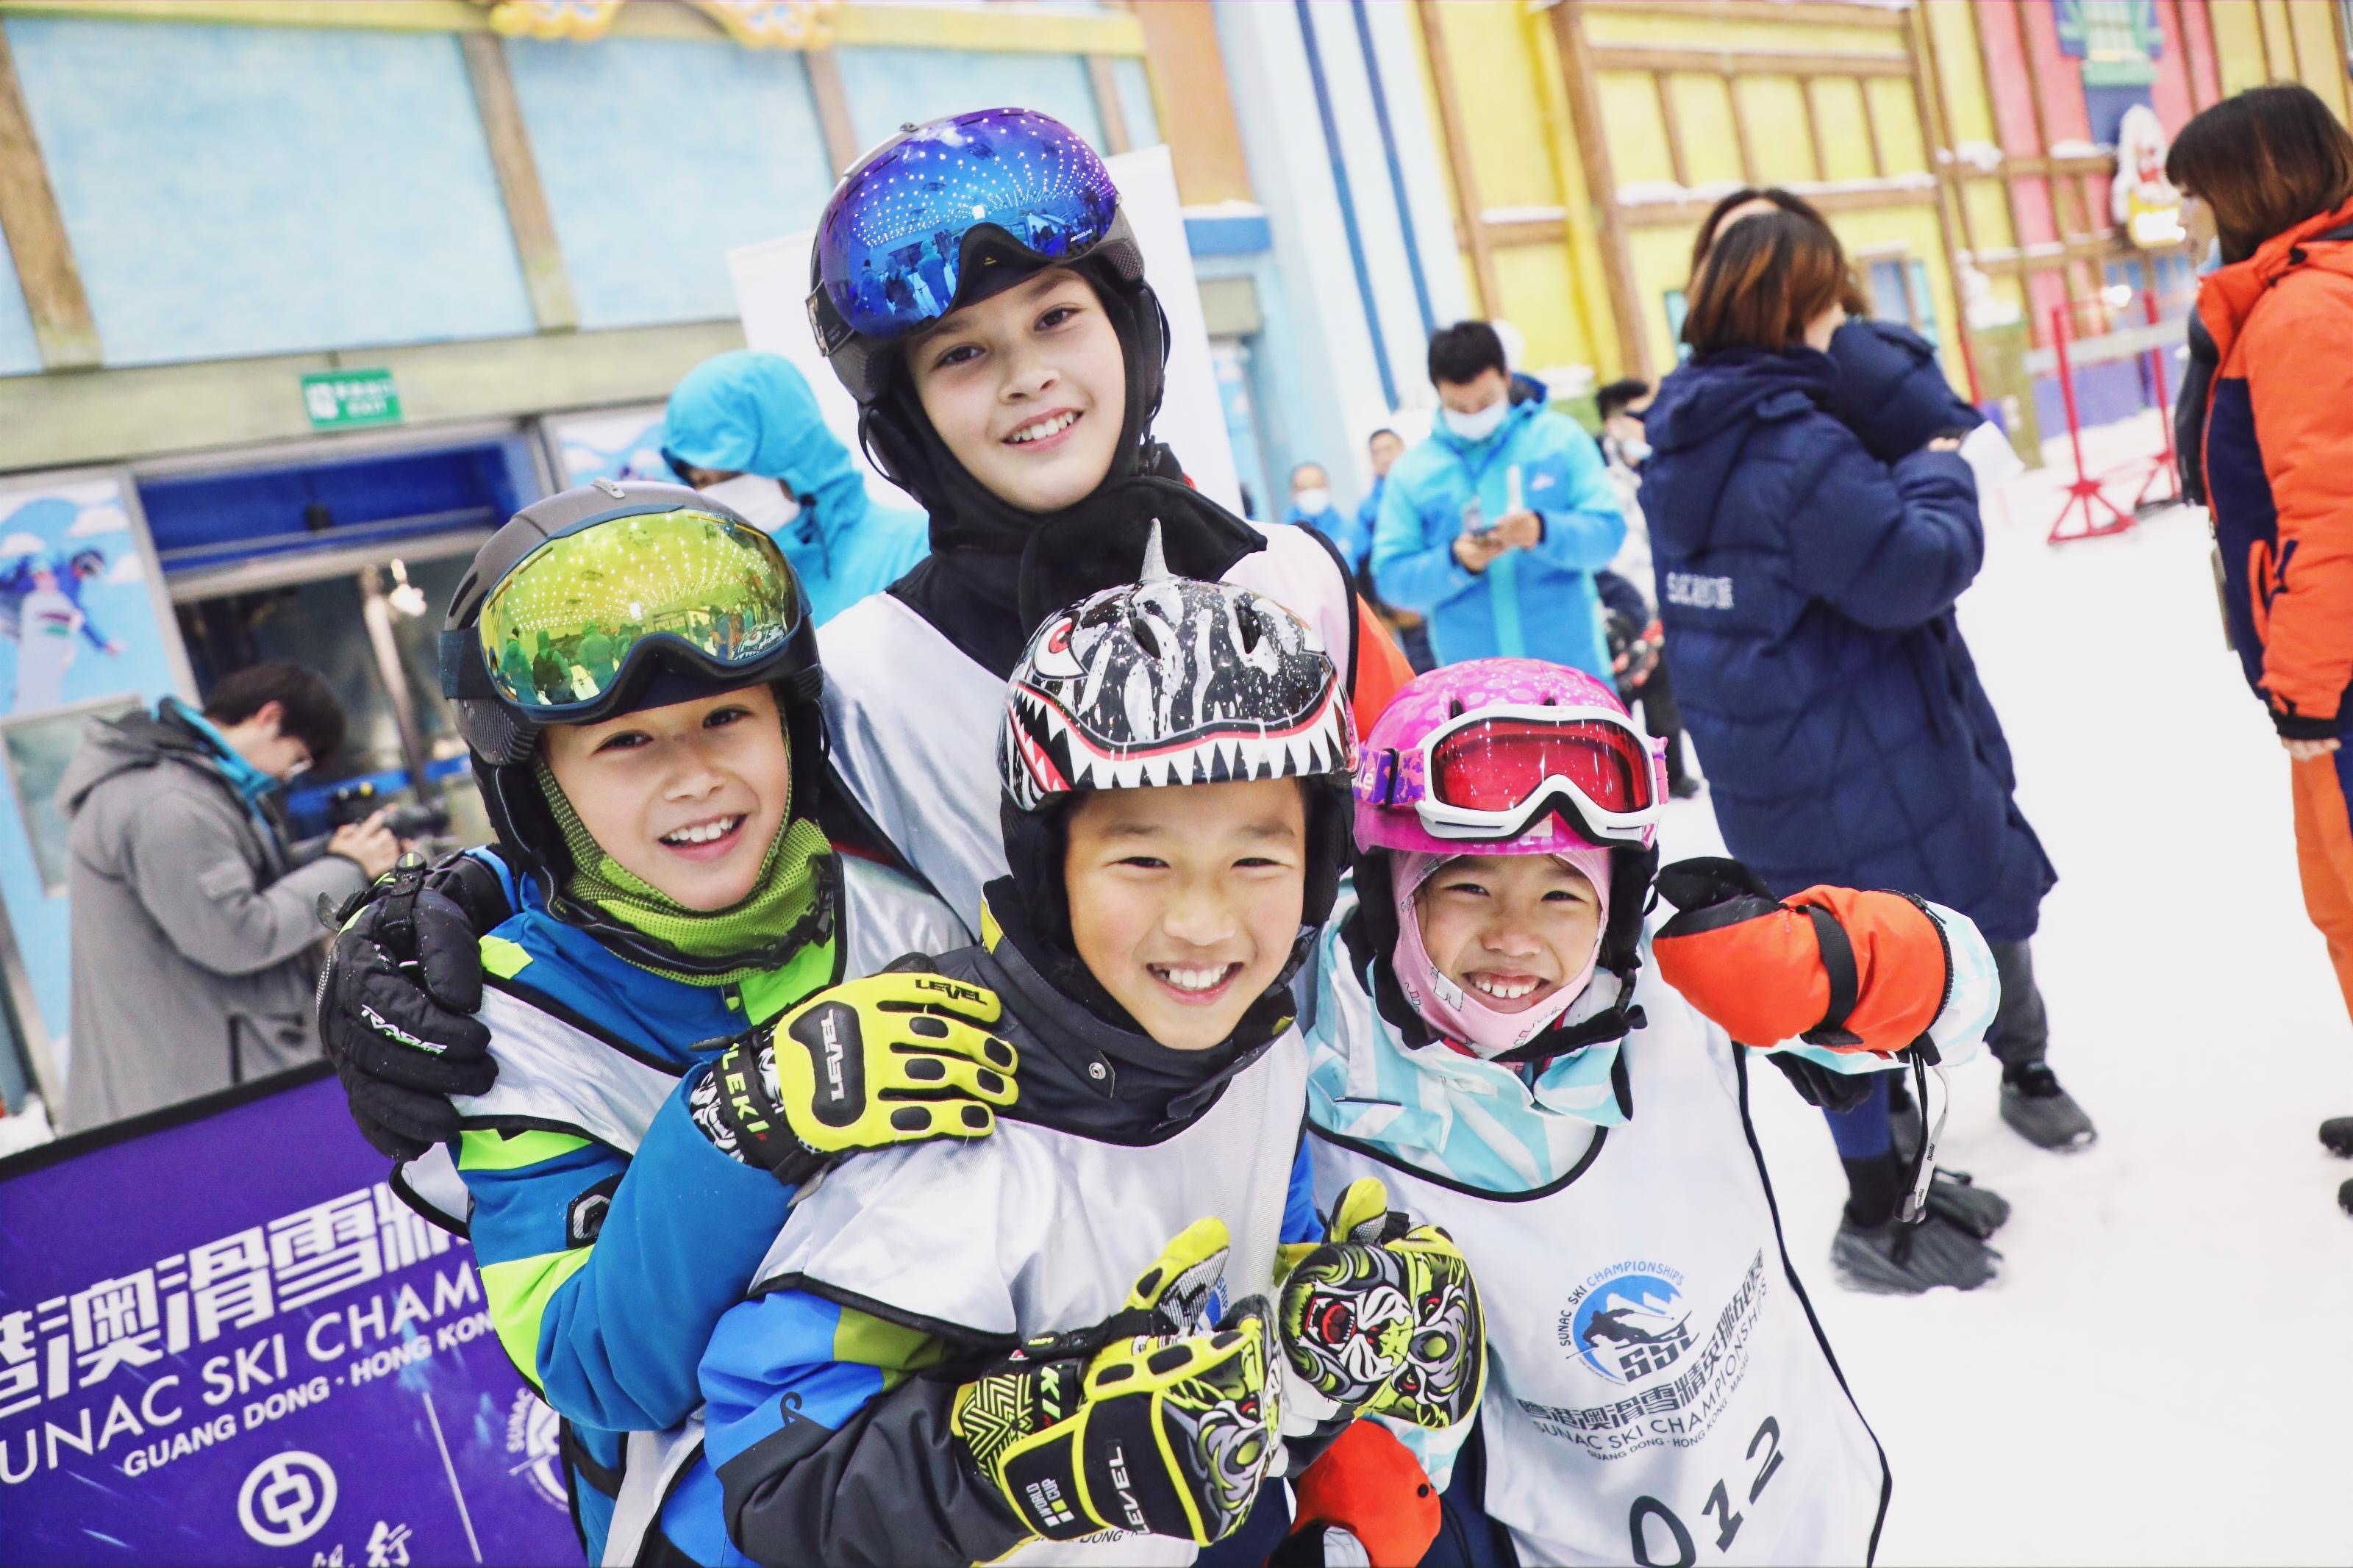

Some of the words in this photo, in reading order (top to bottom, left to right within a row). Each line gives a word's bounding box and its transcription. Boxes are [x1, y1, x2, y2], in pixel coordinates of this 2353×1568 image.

[915, 979, 988, 1006] LEVEL
[722, 1050, 771, 1133] LEKI
[821, 1009, 845, 1101] LEVEL
[201, 1333, 288, 1406] SKI
[305, 1261, 480, 1362] CHAM
[1557, 1309, 1572, 1347] SUNAC
[1568, 1285, 1588, 1305] SKI
[1586, 1261, 1685, 1286] CHAMPIONSHIPS
[124, 1414, 237, 1478] GUANG
[243, 1376, 330, 1431] DONG
[350, 1335, 433, 1387] HONG
[1040, 1364, 1061, 1420] KI
[1533, 1420, 1603, 1450] SUNAC
[1607, 1424, 1644, 1450] SKI
[1650, 1276, 1767, 1433] CHAMPIONSHIPS
[1587, 1449, 1627, 1461] GUANG
[1629, 1437, 1664, 1453] DONG
[1673, 1429, 1706, 1448] HONG
[1706, 1397, 1728, 1431] KONG
[1730, 1351, 1749, 1394] MACAU
[1026, 1482, 1054, 1517] WORLD
[1040, 1478, 1061, 1501] CUP
[1109, 1446, 1151, 1534] LEVEL
[1629, 1415, 1785, 1568] 012
